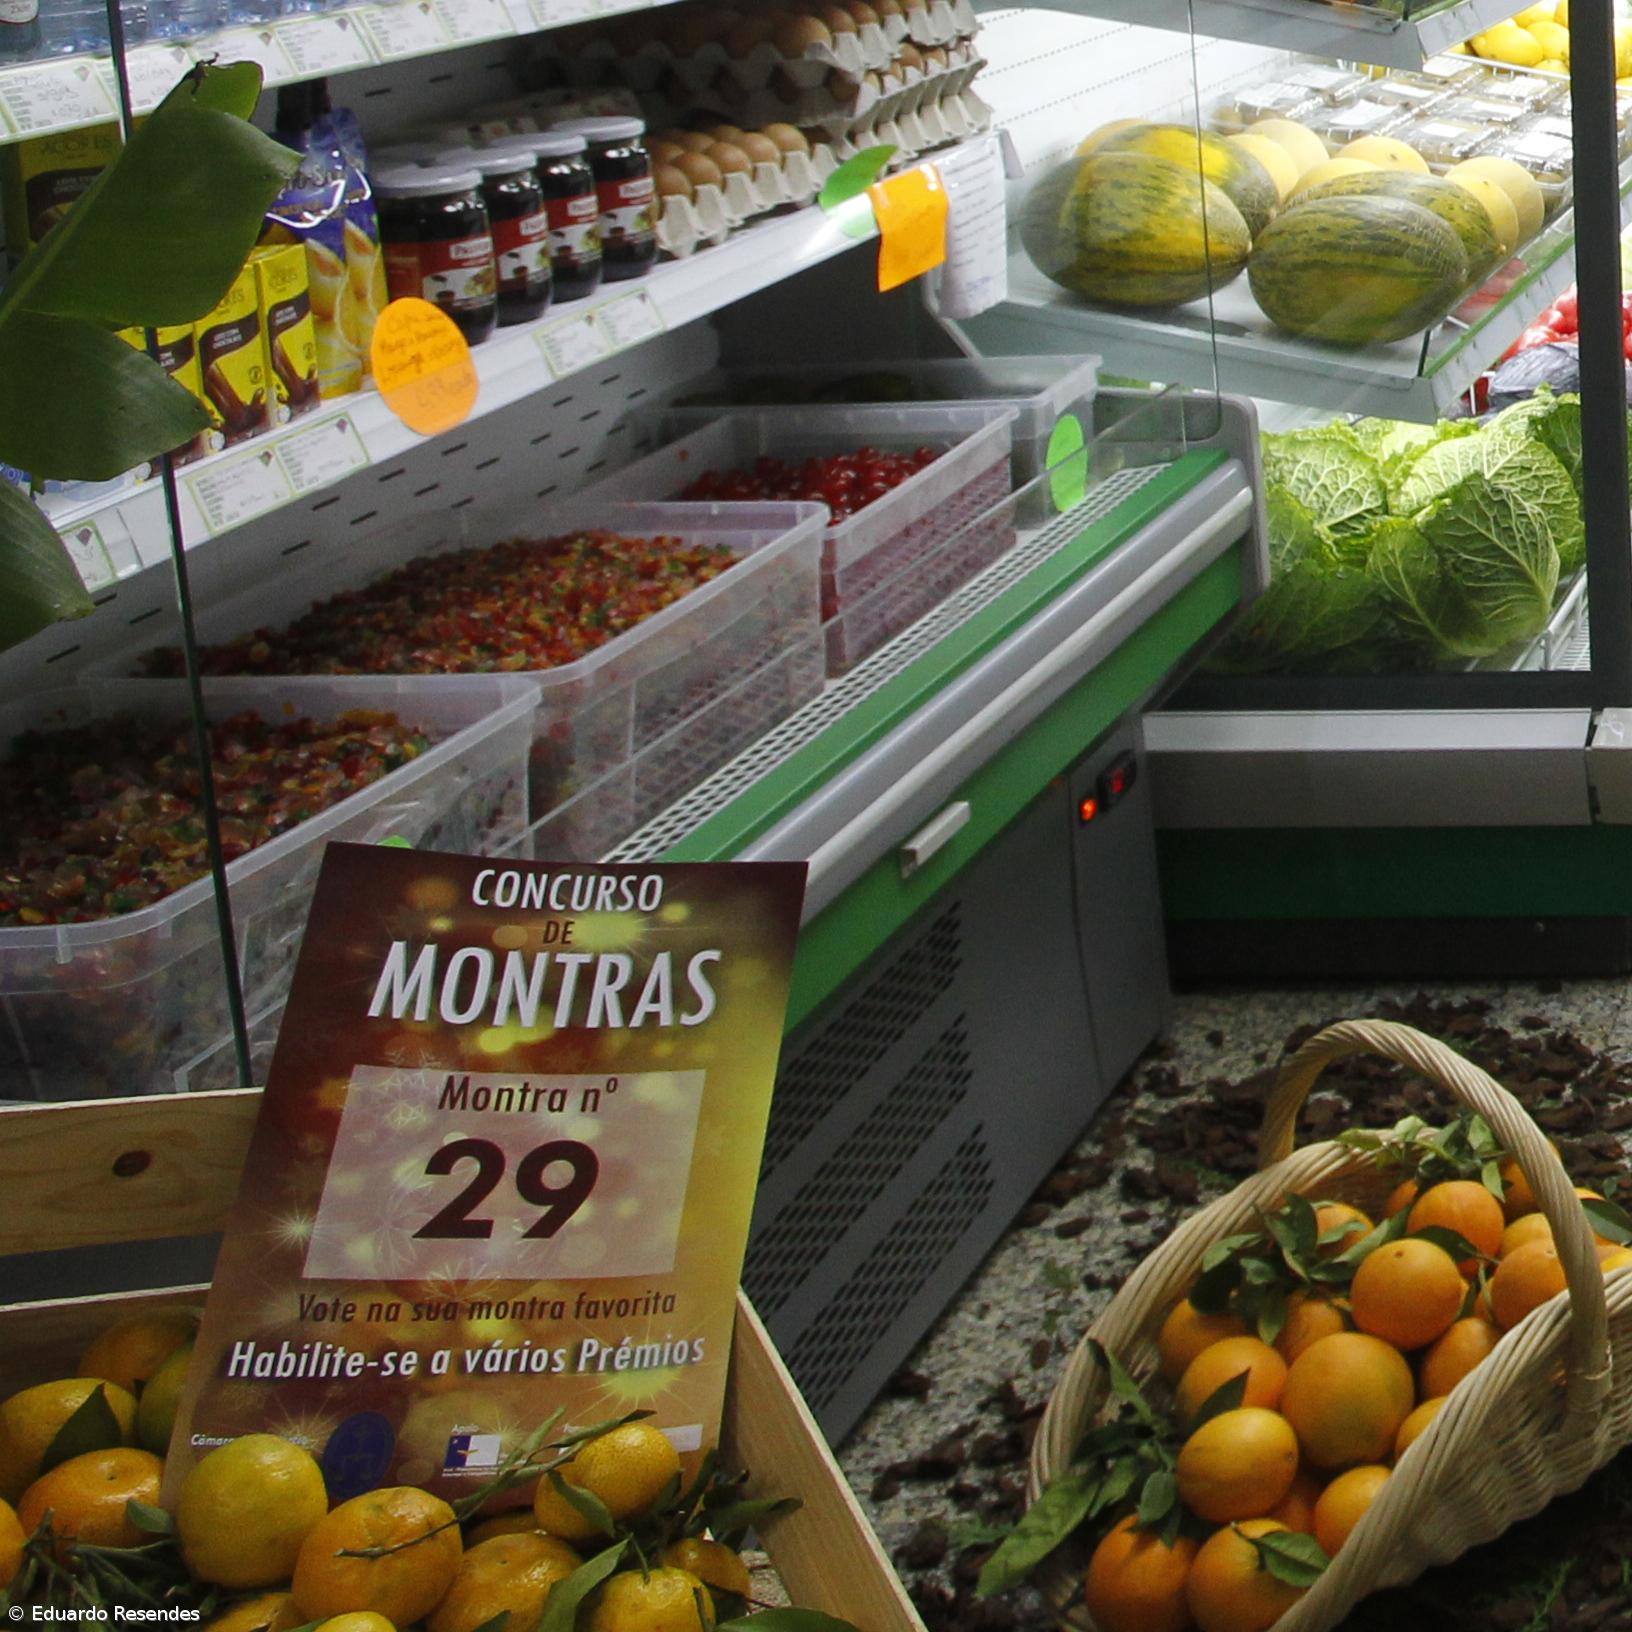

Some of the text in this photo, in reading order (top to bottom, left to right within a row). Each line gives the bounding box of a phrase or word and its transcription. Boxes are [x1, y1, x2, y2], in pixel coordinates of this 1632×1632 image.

[472, 868, 664, 912] CONCURSO
[543, 920, 576, 945] DE
[367, 940, 722, 1029] MONTRAS
[438, 1074, 619, 1113] Montra nº
[412, 1137, 600, 1240] 29
[300, 1290, 676, 1322] Vote na sua montra favorita
[228, 1332, 706, 1378] Habilite-se a vários Prémios
